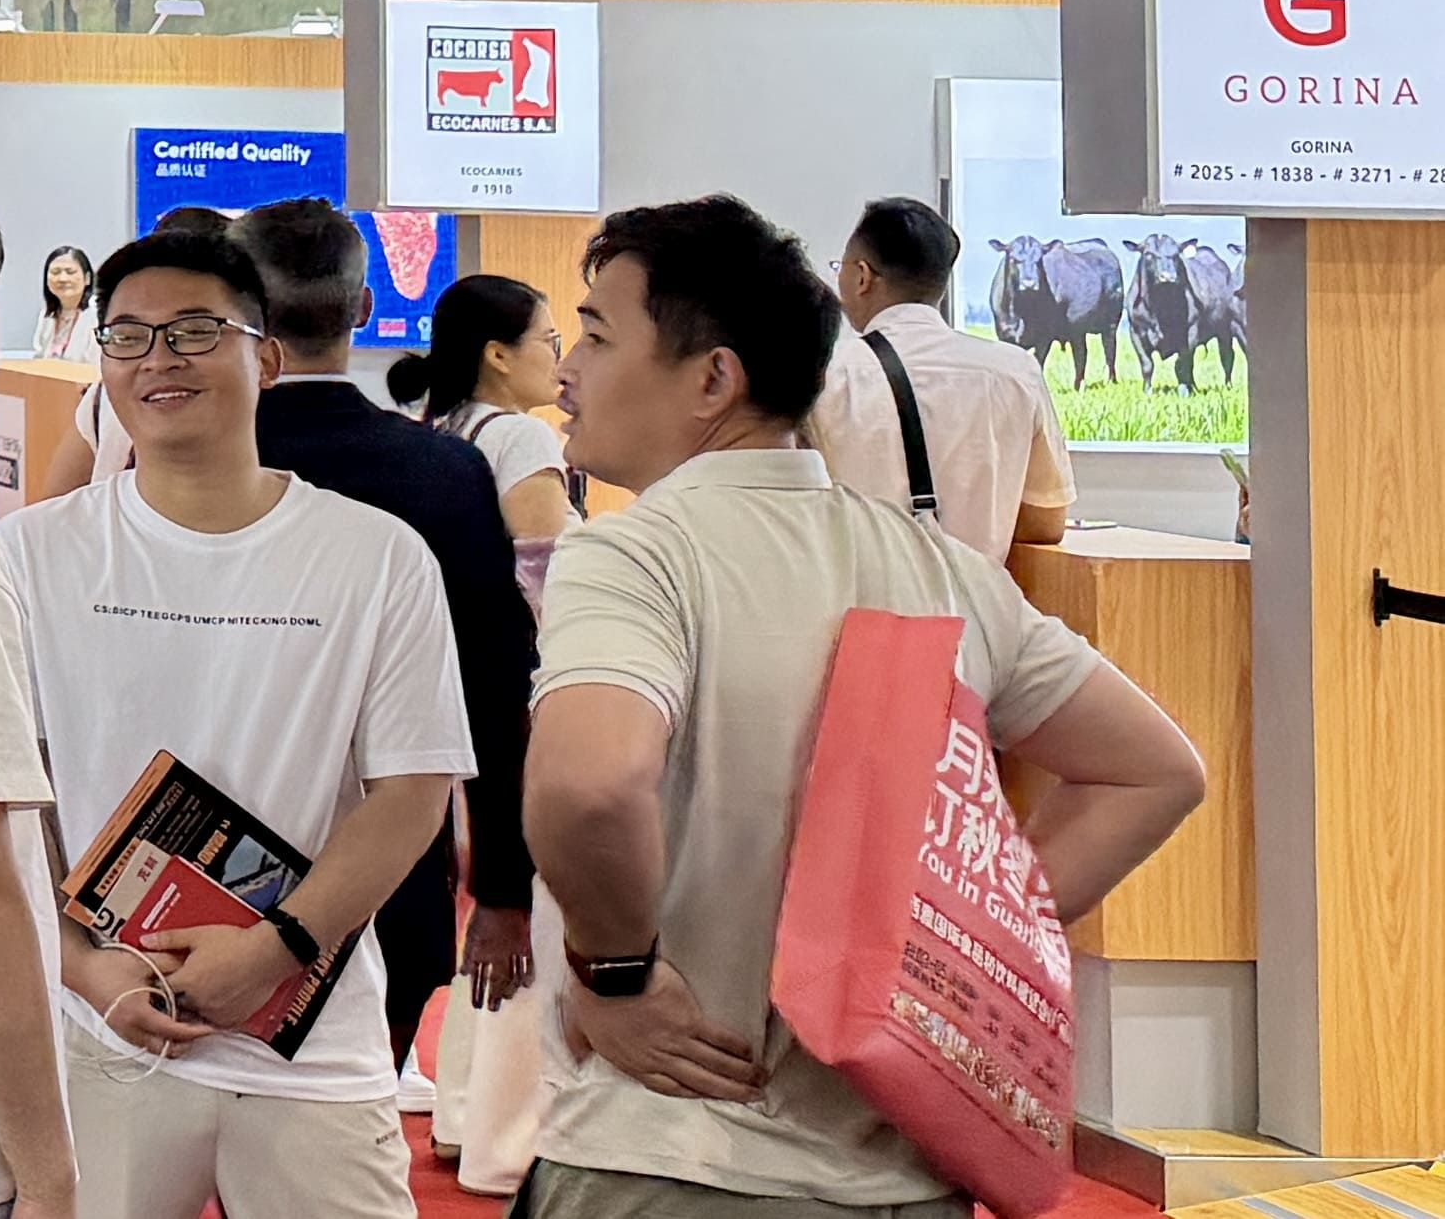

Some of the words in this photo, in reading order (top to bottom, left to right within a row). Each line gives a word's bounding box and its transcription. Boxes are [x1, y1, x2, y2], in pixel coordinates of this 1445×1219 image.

[1224, 75, 1419, 106] GORINA
[431, 115, 521, 132] ECOCARNES
[153, 140, 239, 161] Certified
[242, 142, 311, 166] Quality
[1290, 140, 1353, 155] GORINA
[1190, 164, 1235, 181] 2025
[1270, 166, 1314, 183] 1838
[1349, 167, 1392, 184] 3271
[957, 870, 980, 905] in
